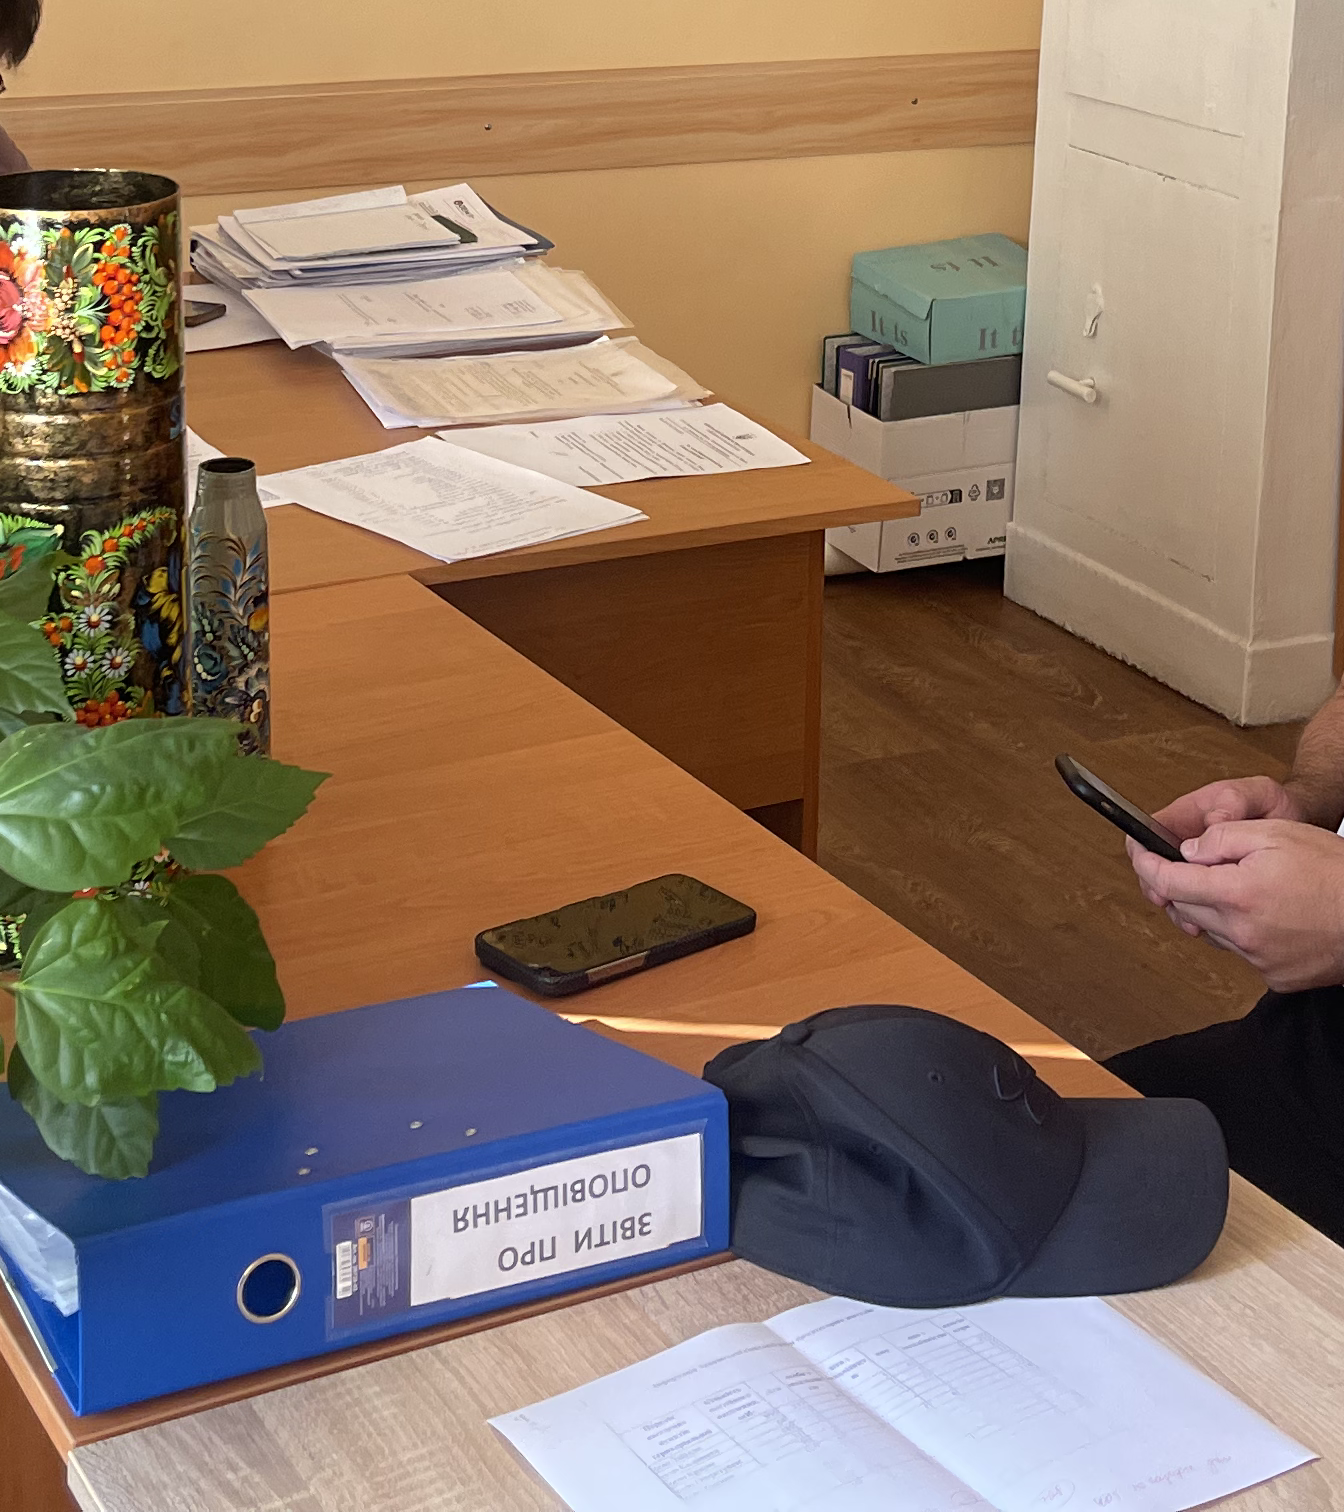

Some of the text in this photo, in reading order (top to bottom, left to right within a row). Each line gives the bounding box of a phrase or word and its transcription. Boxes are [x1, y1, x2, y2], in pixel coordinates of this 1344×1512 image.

[977, 328, 998, 352] It
[452, 1163, 652, 1234] ОПОВІЩЕННЯ
[497, 1212, 652, 1272] ЗВІТИ ПРО
